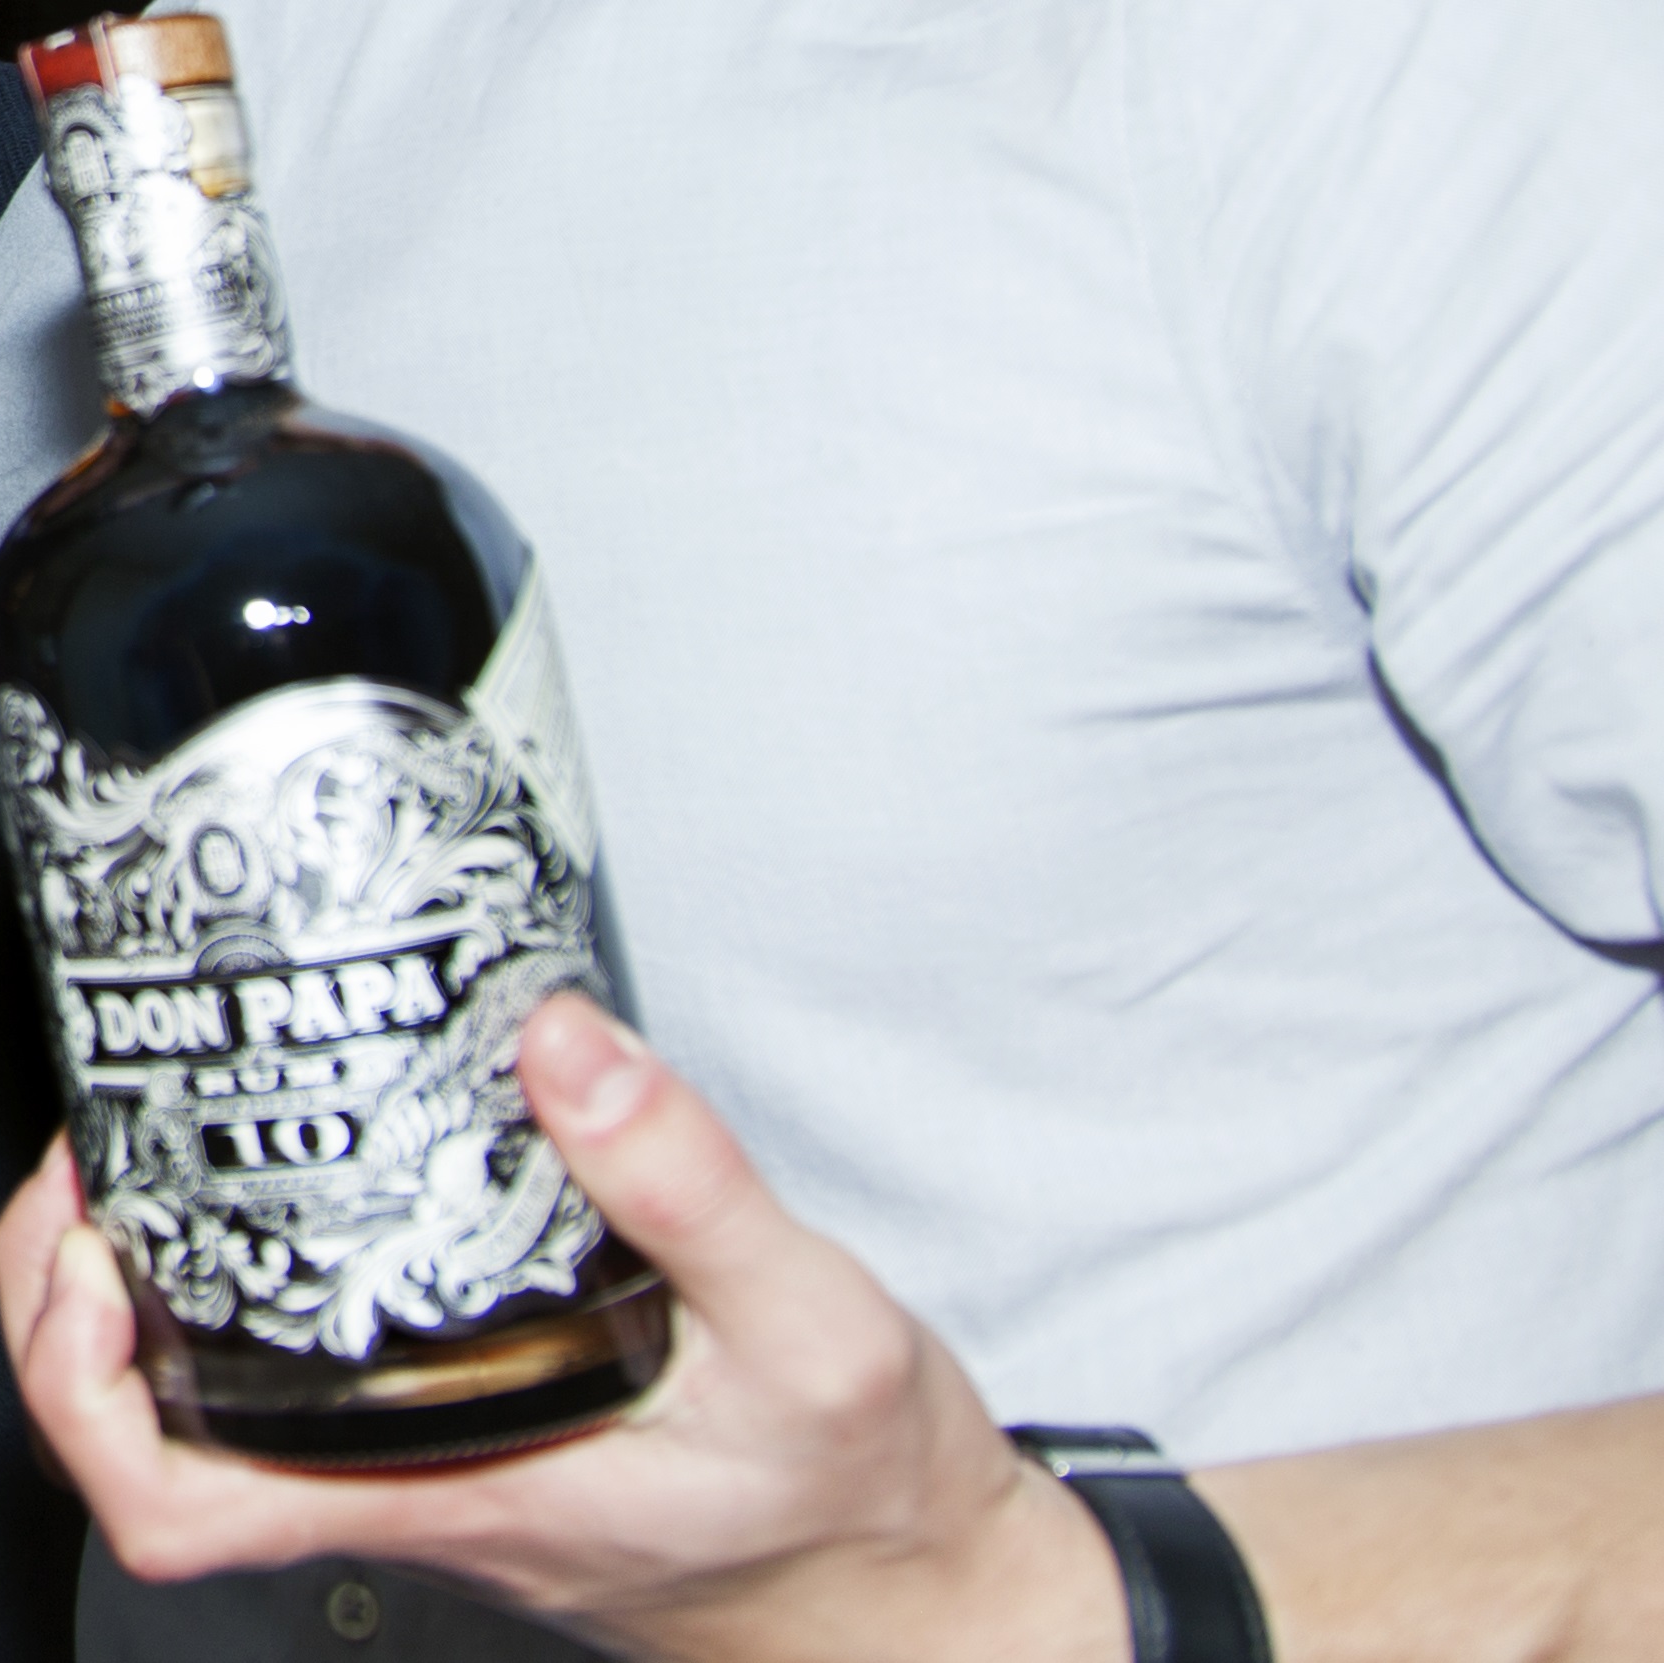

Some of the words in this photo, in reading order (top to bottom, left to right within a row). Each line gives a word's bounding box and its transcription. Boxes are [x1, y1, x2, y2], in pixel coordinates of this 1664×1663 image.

[95, 984, 233, 1057] DON
[236, 954, 449, 1043] PAPA
[224, 1112, 352, 1168] 10
